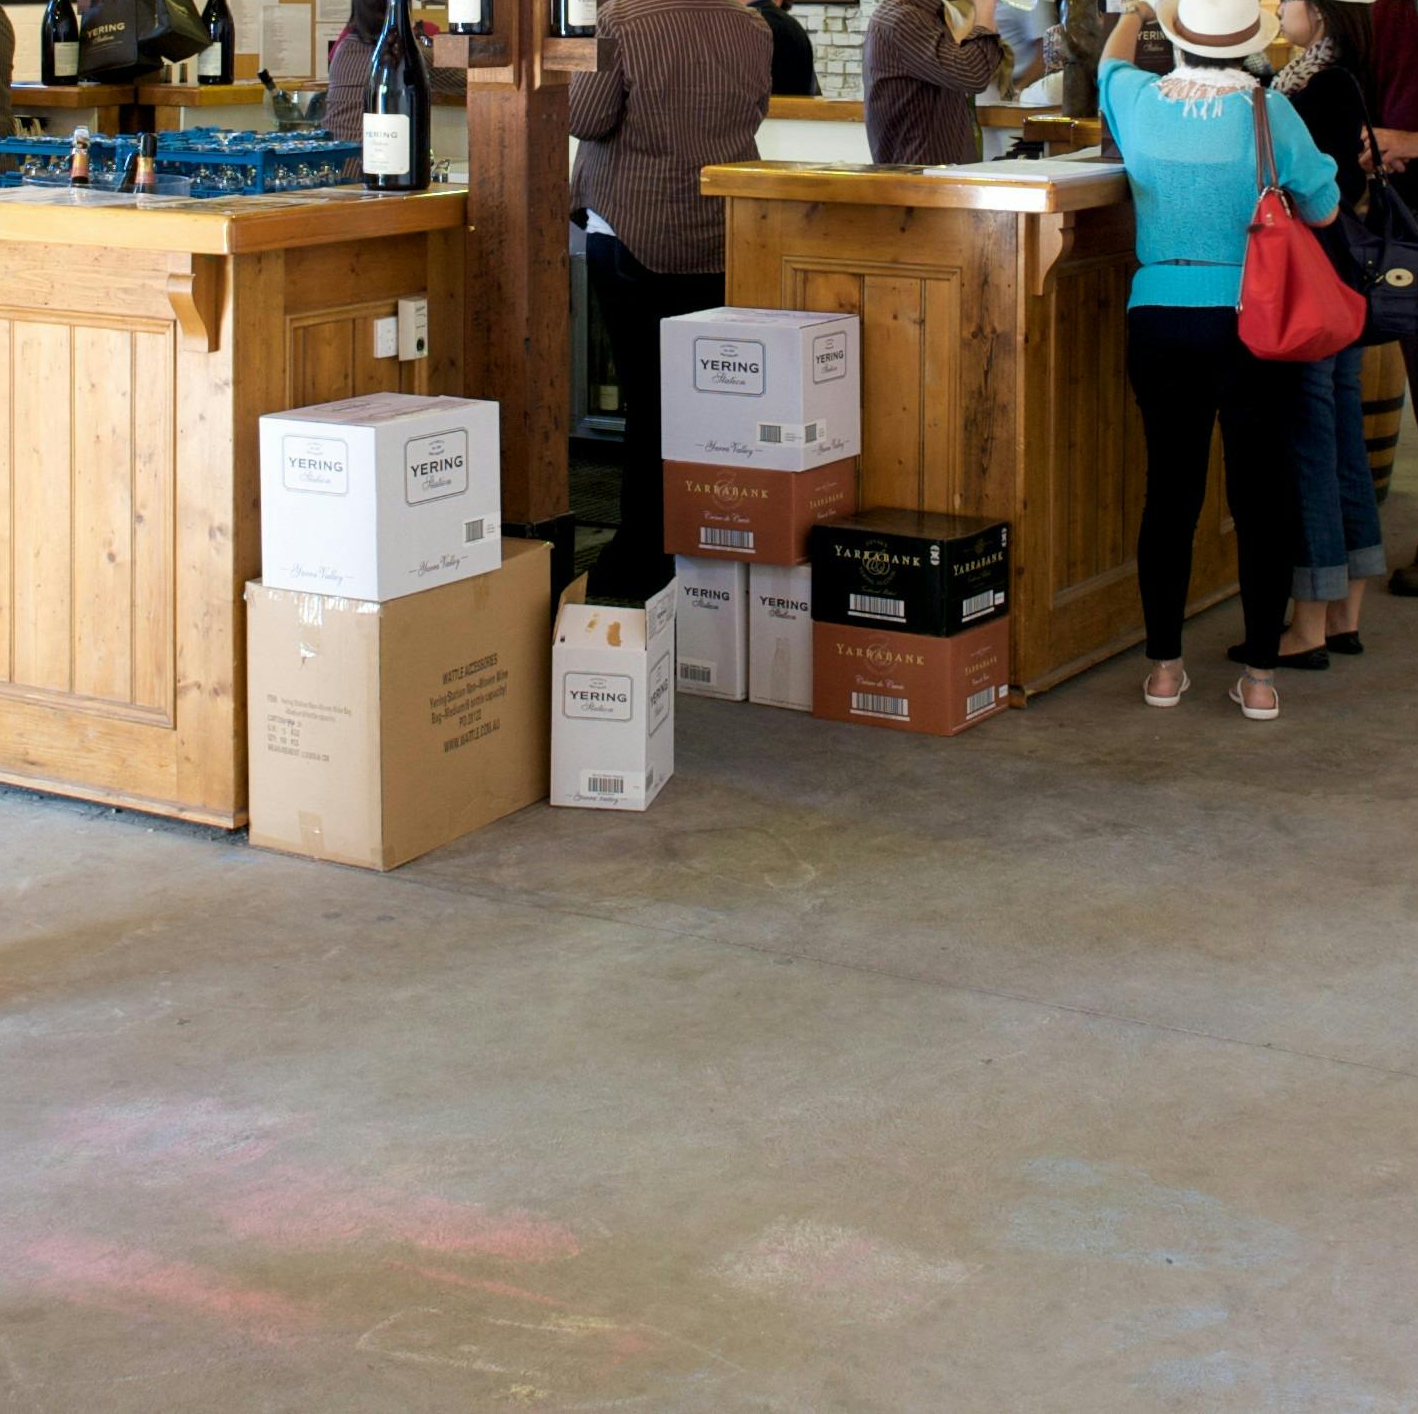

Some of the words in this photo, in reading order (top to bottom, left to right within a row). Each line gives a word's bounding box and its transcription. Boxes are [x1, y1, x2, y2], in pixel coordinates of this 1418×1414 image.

[86, 21, 126, 38] YERING
[1137, 30, 1167, 41] YERIN
[815, 349, 844, 364] YERING
[699, 358, 760, 374] YERING
[711, 371, 747, 386] Station
[288, 456, 344, 473] YERING
[410, 454, 464, 477] YERING
[685, 480, 770, 499] YARRABANK
[834, 544, 922, 568] YARRABANK
[952, 550, 1005, 577] YARRABANK
[683, 586, 730, 602] YERING
[759, 595, 809, 612] YERING
[836, 642, 926, 667] YARRABANK
[569, 689, 628, 704] YERING
